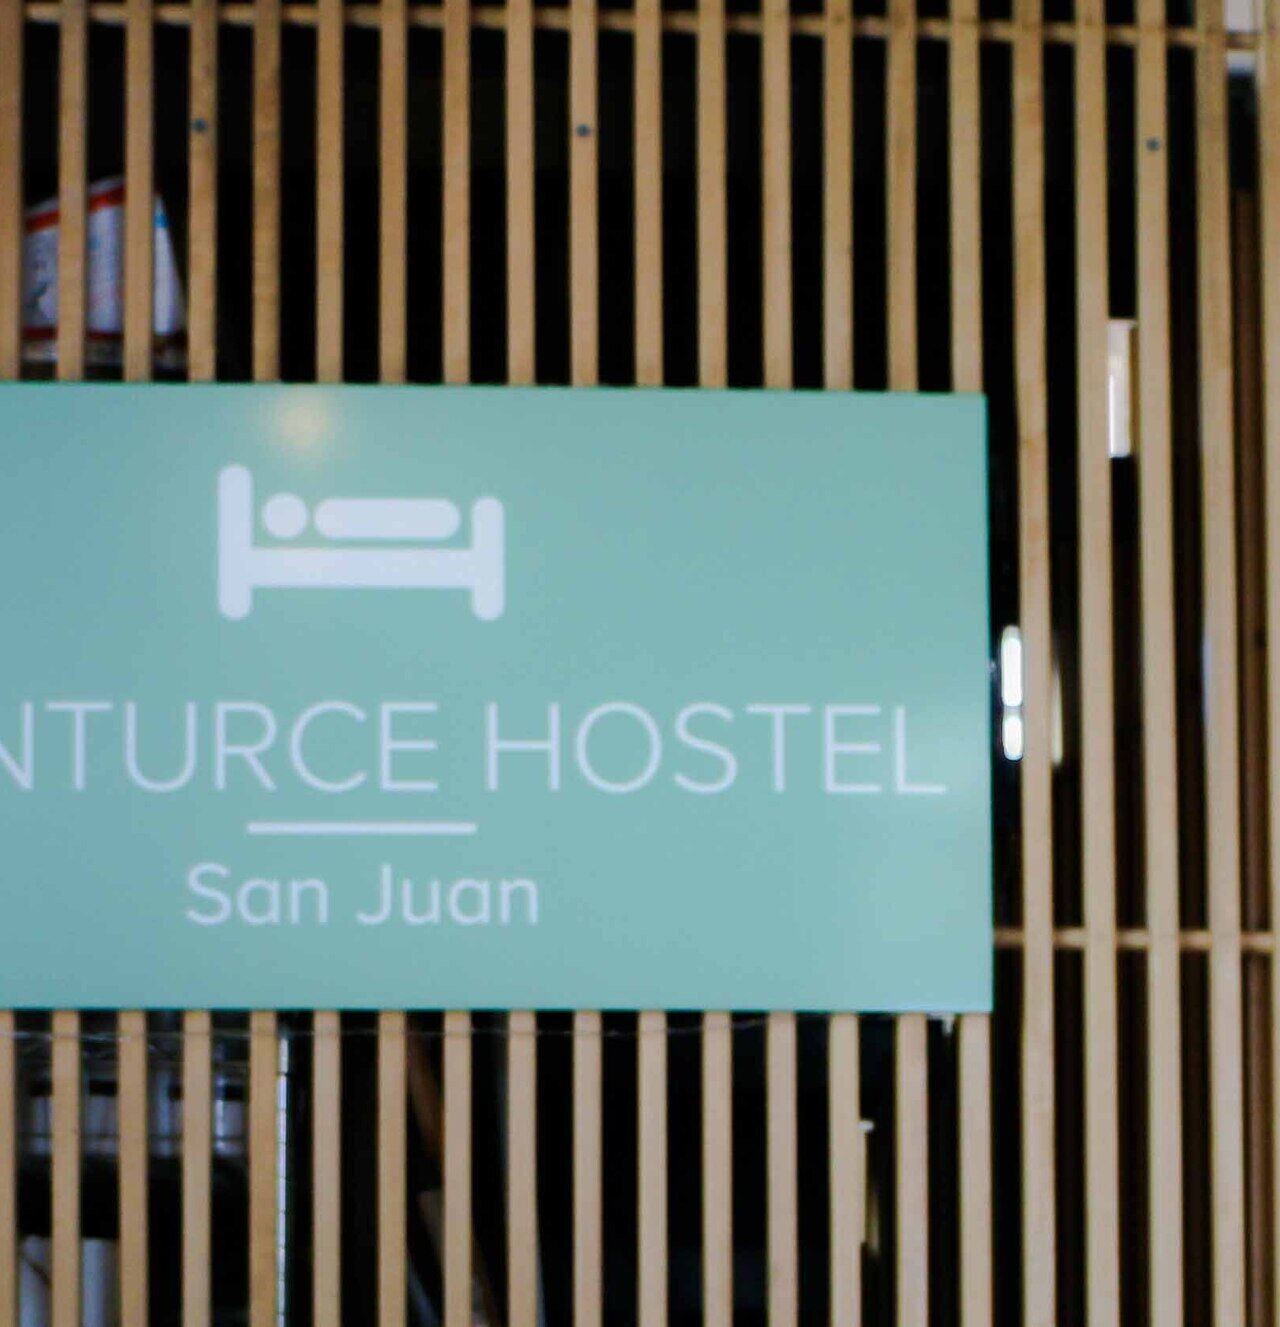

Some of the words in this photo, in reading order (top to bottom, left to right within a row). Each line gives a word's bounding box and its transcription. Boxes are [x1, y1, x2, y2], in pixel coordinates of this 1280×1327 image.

[484, 702, 948, 796] HOSTEL
[184, 862, 330, 926] San
[356, 864, 542, 928] Juan
